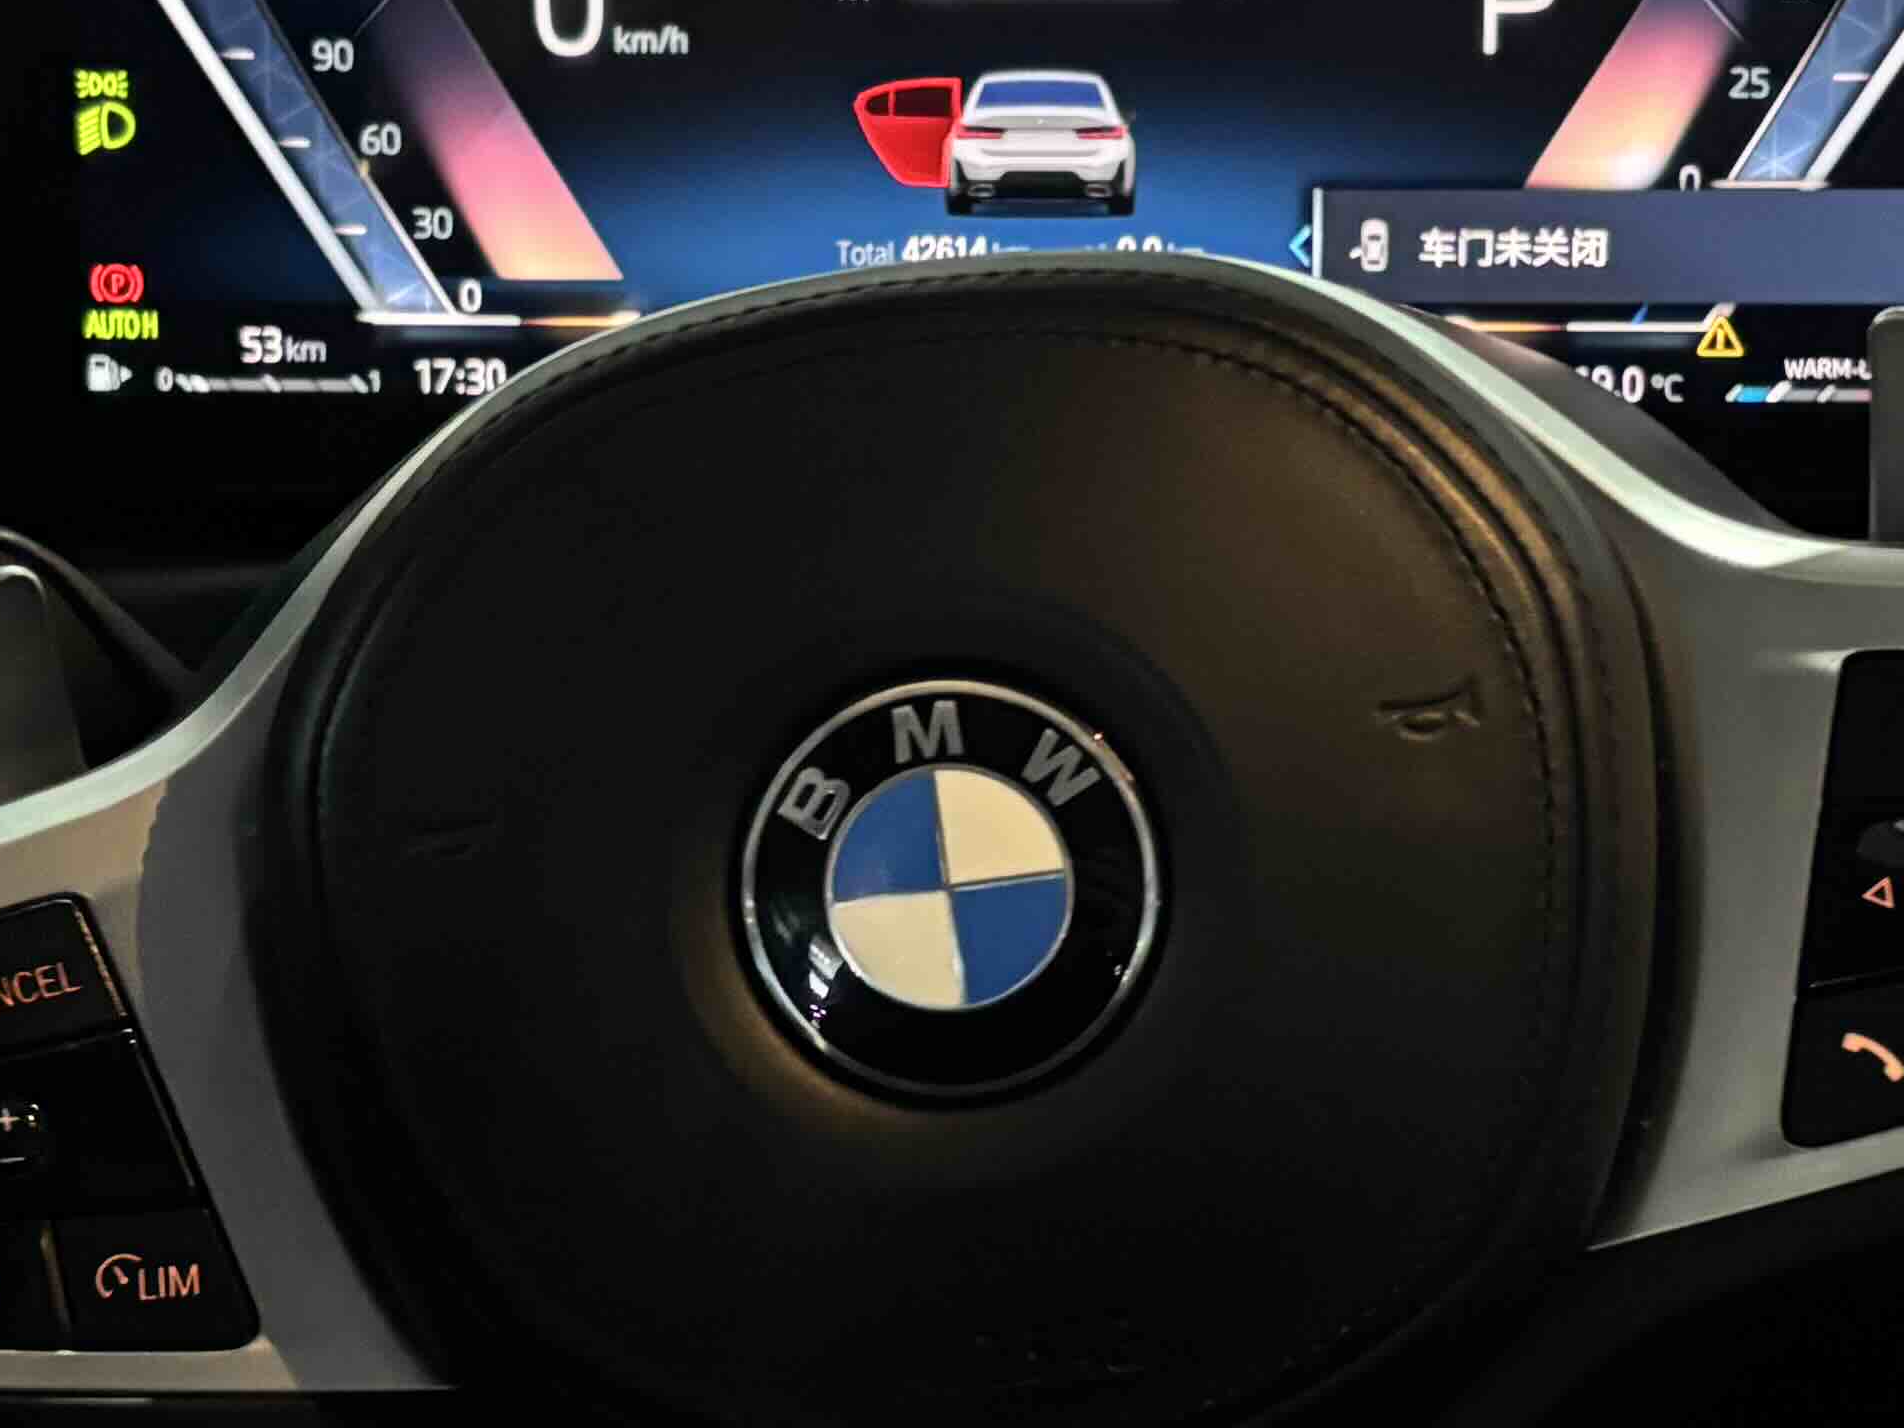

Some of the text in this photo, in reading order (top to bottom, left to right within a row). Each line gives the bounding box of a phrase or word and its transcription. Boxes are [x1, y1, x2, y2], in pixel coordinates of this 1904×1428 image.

[311, 39, 354, 72] 90
[613, 25, 690, 54] km/h
[1728, 66, 1770, 99] 25
[360, 123, 402, 156] 60
[412, 208, 454, 241] 30
[835, 240, 895, 268] Total
[1418, 227, 1609, 269] 车门未关闭
[458, 281, 483, 314] 0
[412, 357, 508, 397] 17:30
[1575, 364, 1645, 403] 9.0
[776, 699, 1100, 840] BMW
[137, 1262, 201, 1302] LIM
